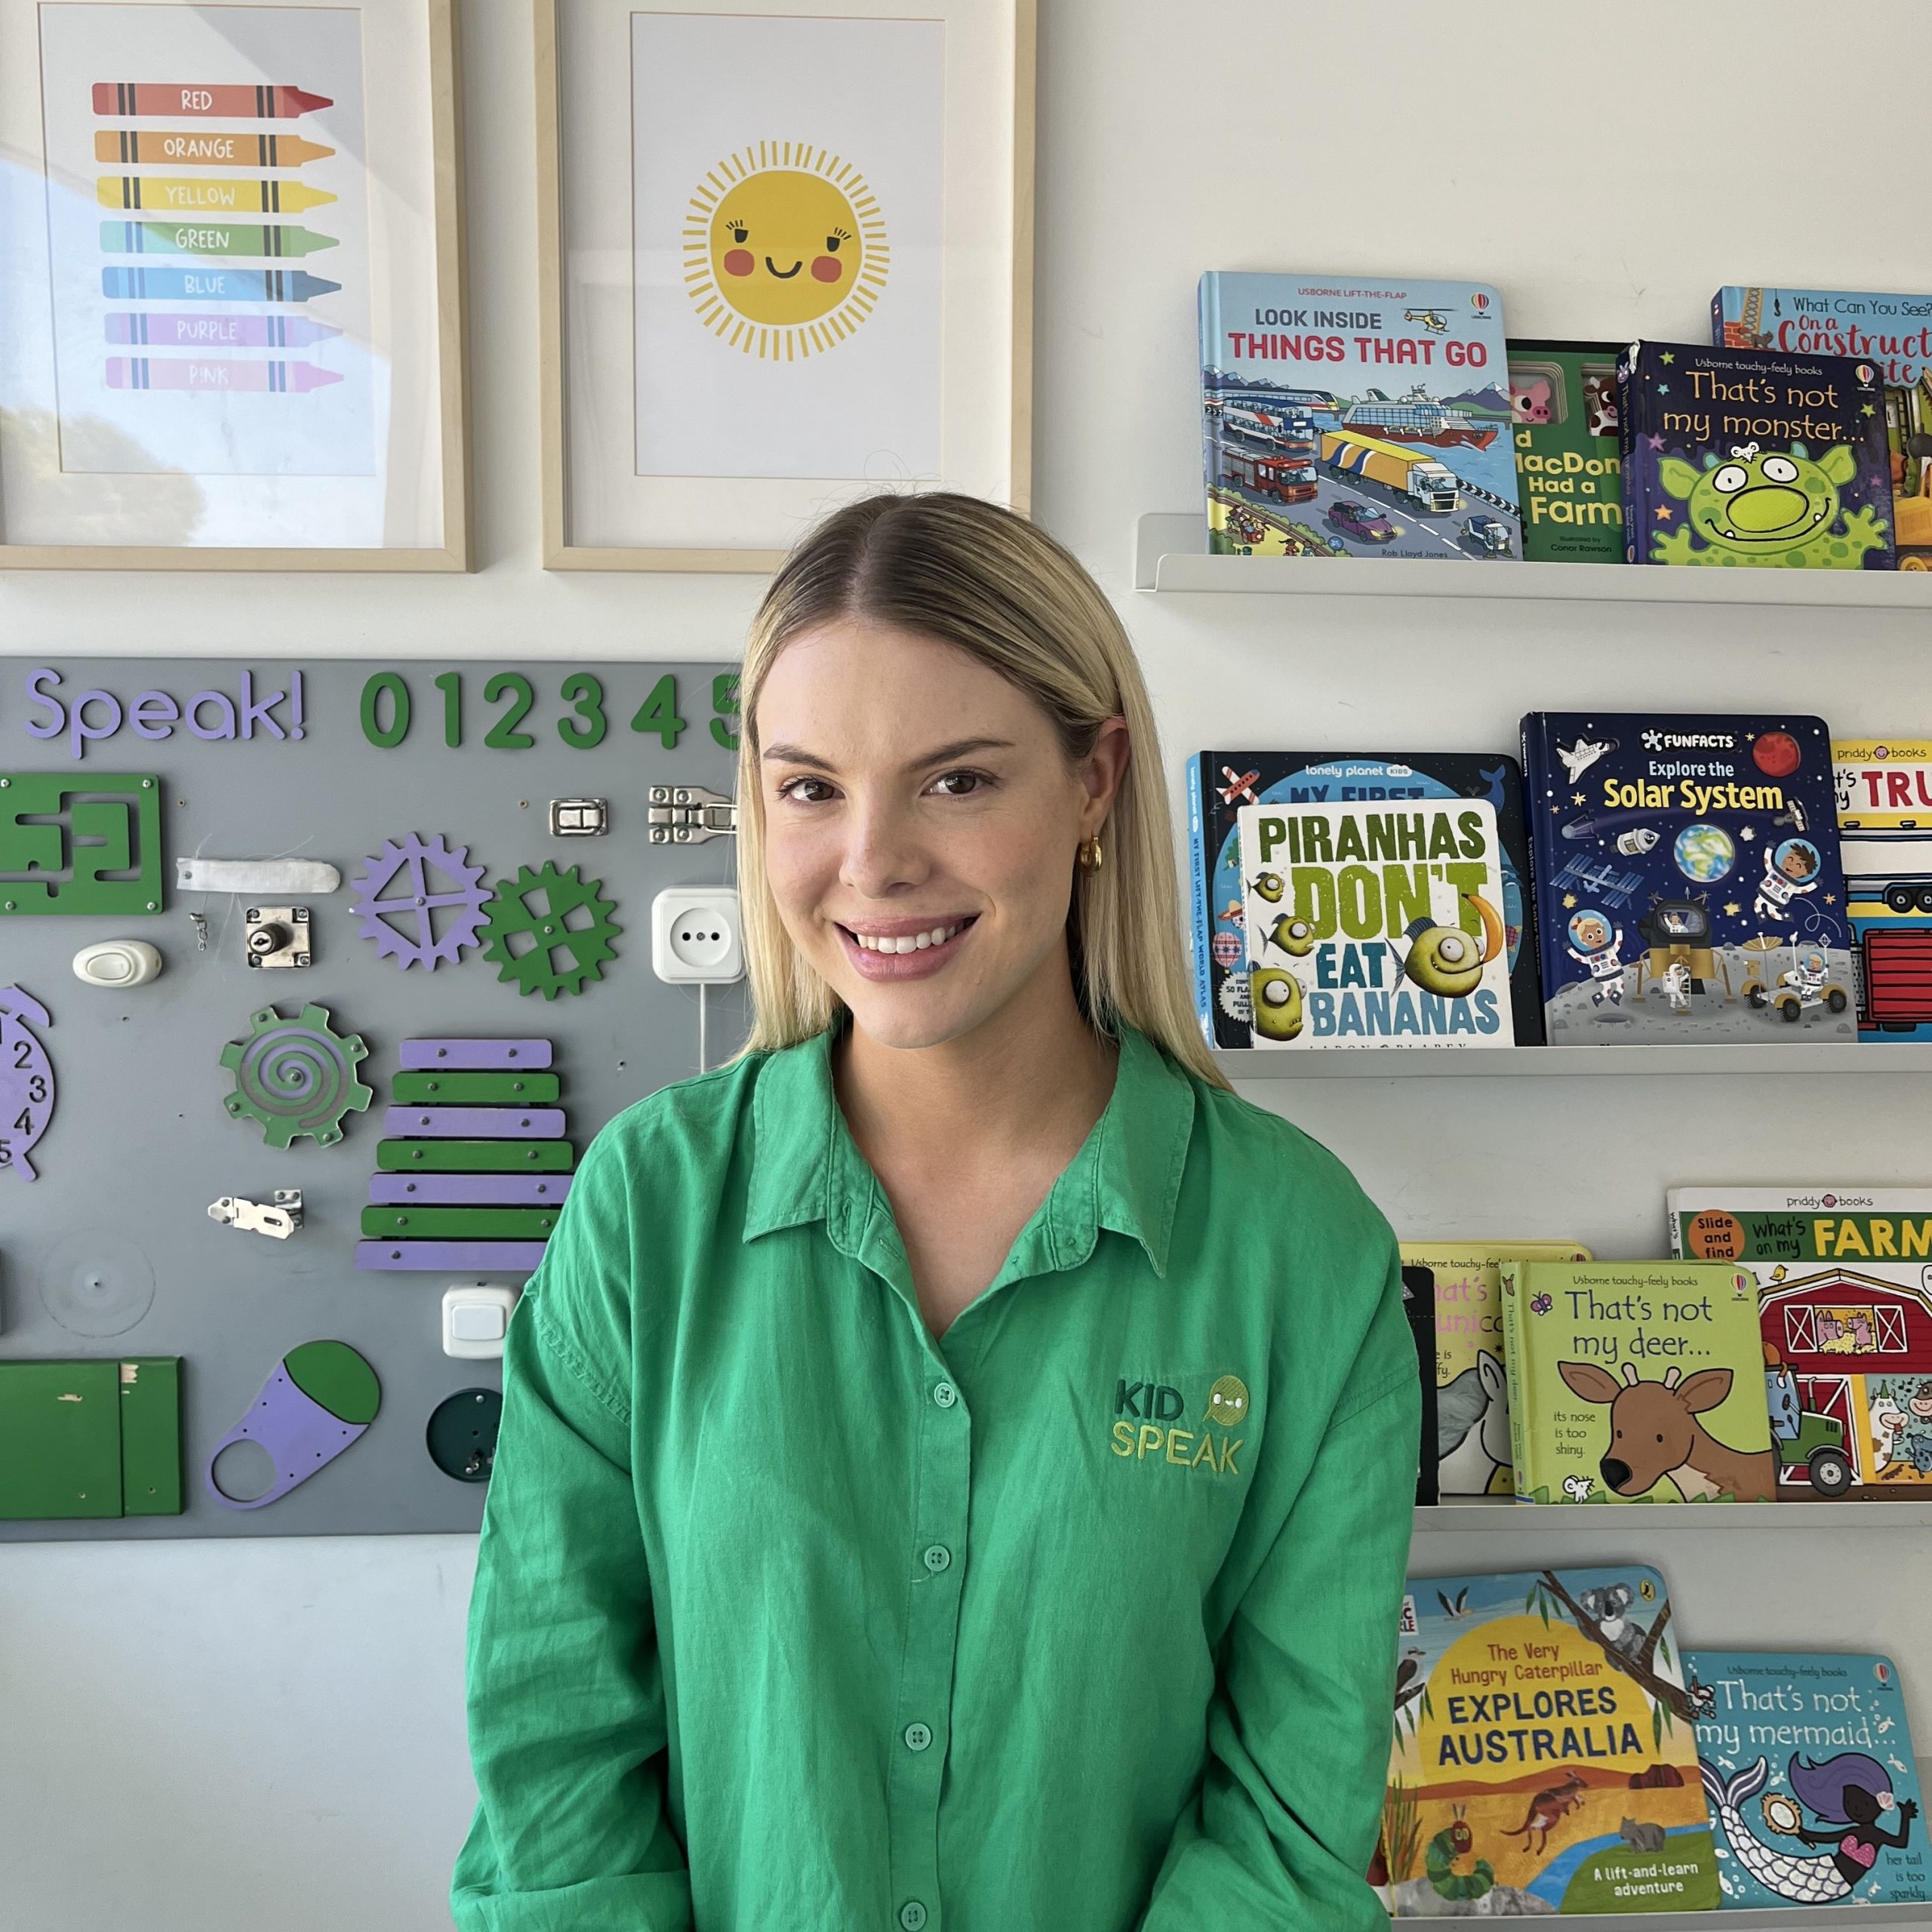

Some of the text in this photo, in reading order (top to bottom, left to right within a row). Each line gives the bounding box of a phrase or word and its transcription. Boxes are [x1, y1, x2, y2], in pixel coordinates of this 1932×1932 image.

[181, 89, 213, 111] RED
[163, 137, 235, 159] ORANGE
[165, 185, 235, 206] YELLOW
[176, 229, 230, 249] GREEN
[184, 275, 226, 295] BLUE
[1298, 288, 1407, 300] USBORNE LIFT-THE-FLAP
[1793, 297, 1932, 317] What Can You See?
[1255, 308, 1383, 331] LOOK INSIDE
[1798, 314, 1839, 331] On a
[177, 321, 237, 340] PURPLE
[1228, 332, 1487, 368] THINGS THAT GO
[189, 364, 229, 385] PINK
[1694, 358, 1823, 376] Usborne touchy-feely books
[1685, 370, 1839, 409] That's not
[1663, 412, 1865, 441] my monster...
[1528, 476, 1596, 494] Had a
[1531, 497, 1623, 525] Farm
[1550, 543, 1612, 553] Conor Rawson
[1592, 536, 1601, 544] by
[1382, 549, 1448, 559] Rob Lloyd Jones
[23, 667, 305, 759] Speak!
[360, 671, 410, 749] 0
[435, 672, 461, 749] 1
[483, 671, 534, 749] 2
[557, 672, 608, 749] 3
[630, 673, 687, 750] 4
[1663, 734, 1735, 749] FUNFACTS
[1838, 747, 1927, 761] priddy books
[1305, 765, 1343, 778] lonely
[1346, 765, 1383, 777] planet
[1648, 760, 1734, 780] Explore the
[1291, 785, 1329, 803] MY
[1604, 778, 1783, 816] Solar System
[1193, 838, 1200, 849] MY
[1259, 811, 1487, 864] PIRANHAS
[1291, 862, 1488, 940] DON'T
[1315, 941, 1387, 990] EAT
[1309, 989, 1500, 1037] BANANAS
[14, 1040, 32, 1069] 2
[29, 1075, 48, 1103] 3
[14, 1107, 35, 1136] 4
[1786, 1195, 1873, 1209] priddy books
[1698, 1217, 1733, 1229] Slide
[1704, 1232, 1731, 1244] and
[1814, 1219, 1932, 1257] FARM
[1706, 1247, 1734, 1259] find
[1756, 1238, 1801, 1259] on my
[1411, 1258, 1500, 1272] Usborne touchy-fee
[1573, 1275, 1698, 1288] Usborne touchy-feely books
[1564, 1289, 1713, 1322] That's not
[1444, 1350, 1452, 1359] is
[1574, 1327, 1710, 1364] my deer...
[1114, 1379, 1184, 1421] KID
[1554, 1411, 1595, 1422] its nose
[1555, 1428, 1587, 1438] is too
[1110, 1420, 1244, 1475] SPEAK
[1555, 1441, 1586, 1458] shiny.
[1487, 1642, 1559, 1661] The Very
[1451, 1660, 1603, 1687] Hungry Caterpillar
[1821, 1666, 1848, 1677] books
[1447, 1686, 1617, 1724] EXPLORES
[1716, 1678, 1862, 1713] That's not
[1438, 1723, 1644, 1766] AUSTRALIA
[1695, 1716, 1896, 1755] my mermaid...
[1885, 1851, 1922, 1866] her tail
[1594, 1863, 1699, 1881] A lift-and-learn
[1896, 1871, 1926, 1882] is too
[1614, 1881, 1684, 1897] adventure
